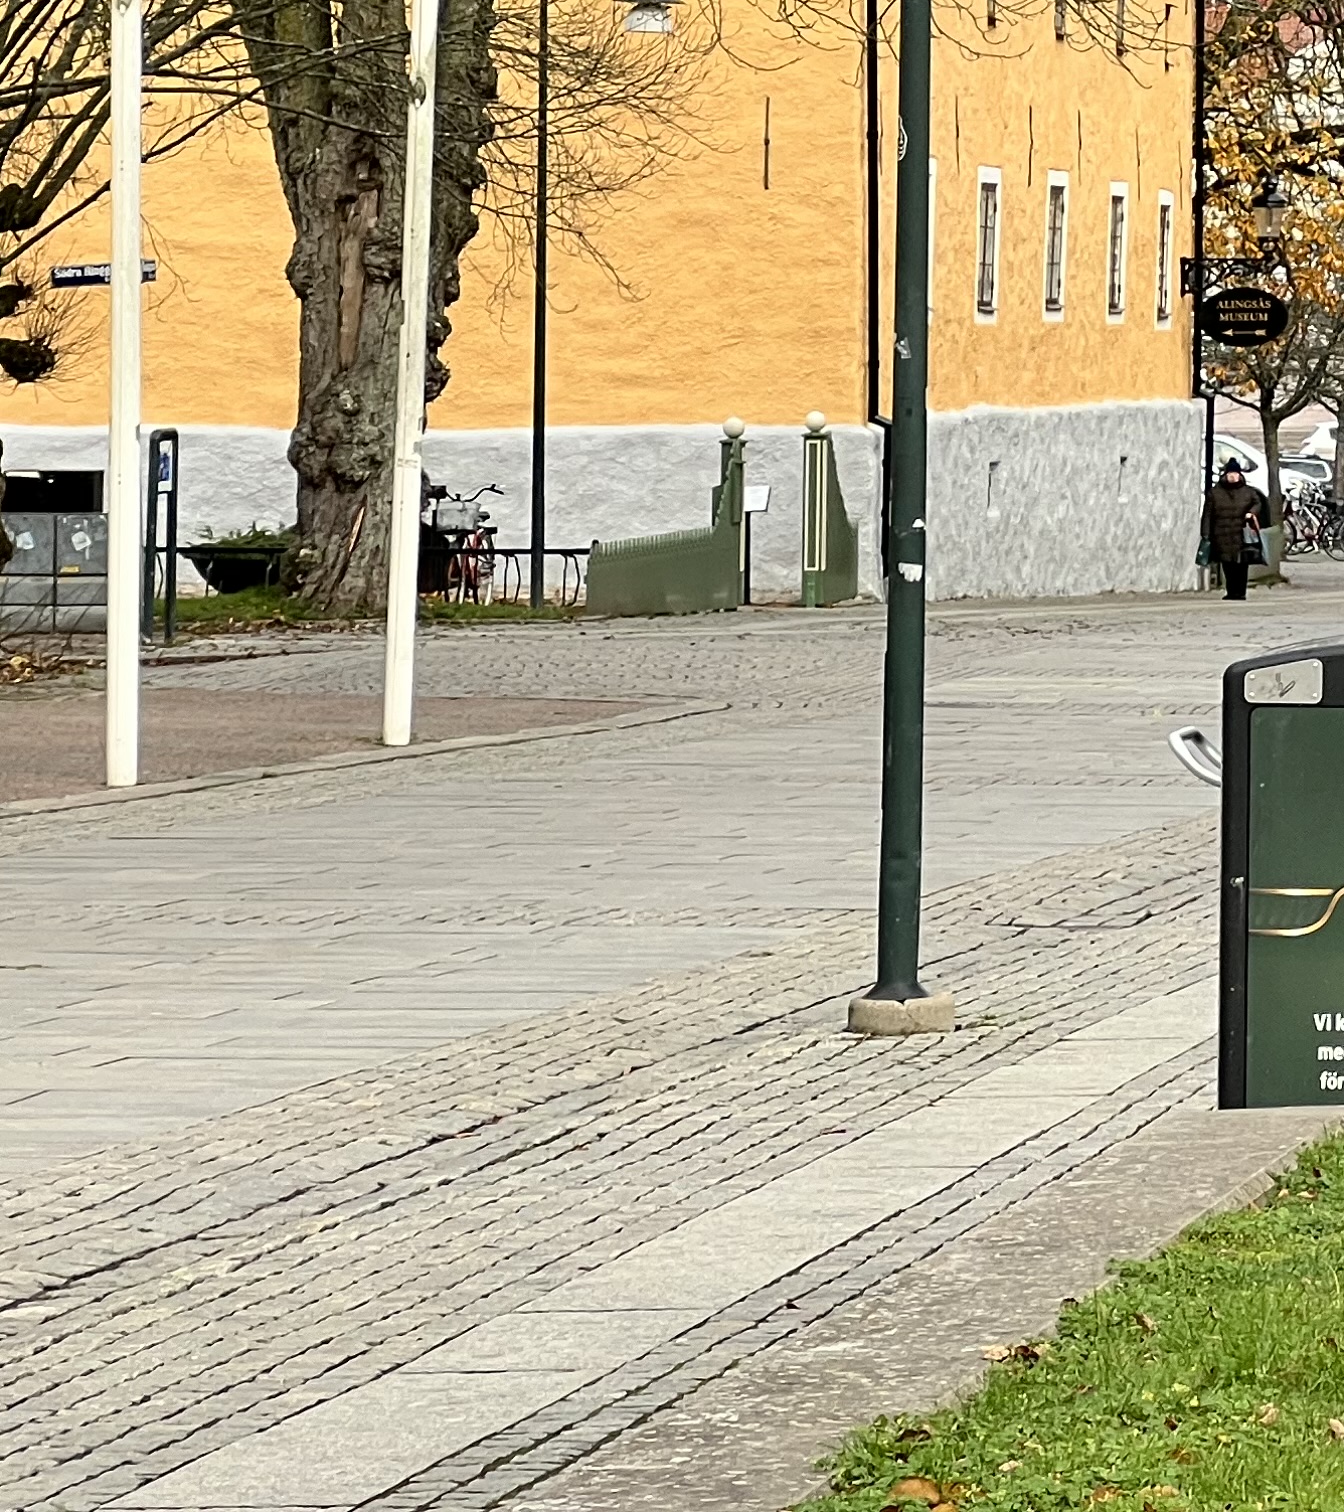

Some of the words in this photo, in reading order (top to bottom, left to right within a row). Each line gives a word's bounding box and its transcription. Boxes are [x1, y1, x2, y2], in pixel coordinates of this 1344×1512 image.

[1217, 298, 1271, 308] ALINGSÅS
[1219, 312, 1268, 321] MUSEUM
[1313, 1013, 1332, 1032] Vi
[1319, 1071, 1344, 1090] för
